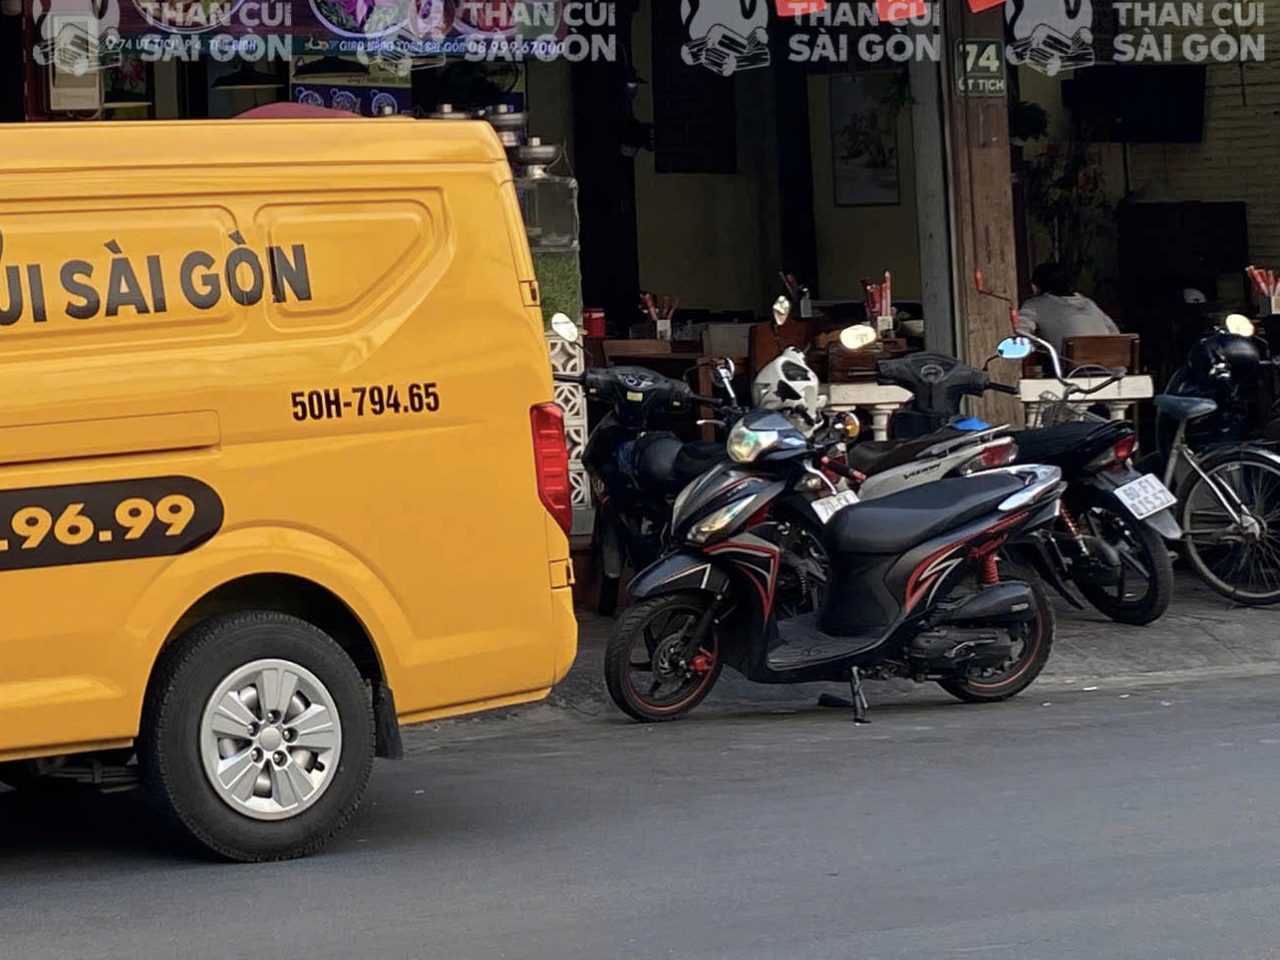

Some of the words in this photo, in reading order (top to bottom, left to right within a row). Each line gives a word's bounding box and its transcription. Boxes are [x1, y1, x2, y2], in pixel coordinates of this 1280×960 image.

[959, 43, 1001, 73] 74
[59, 239, 168, 320] SÀI
[179, 229, 314, 311] GÒN
[290, 382, 441, 423] 50H-794.65
